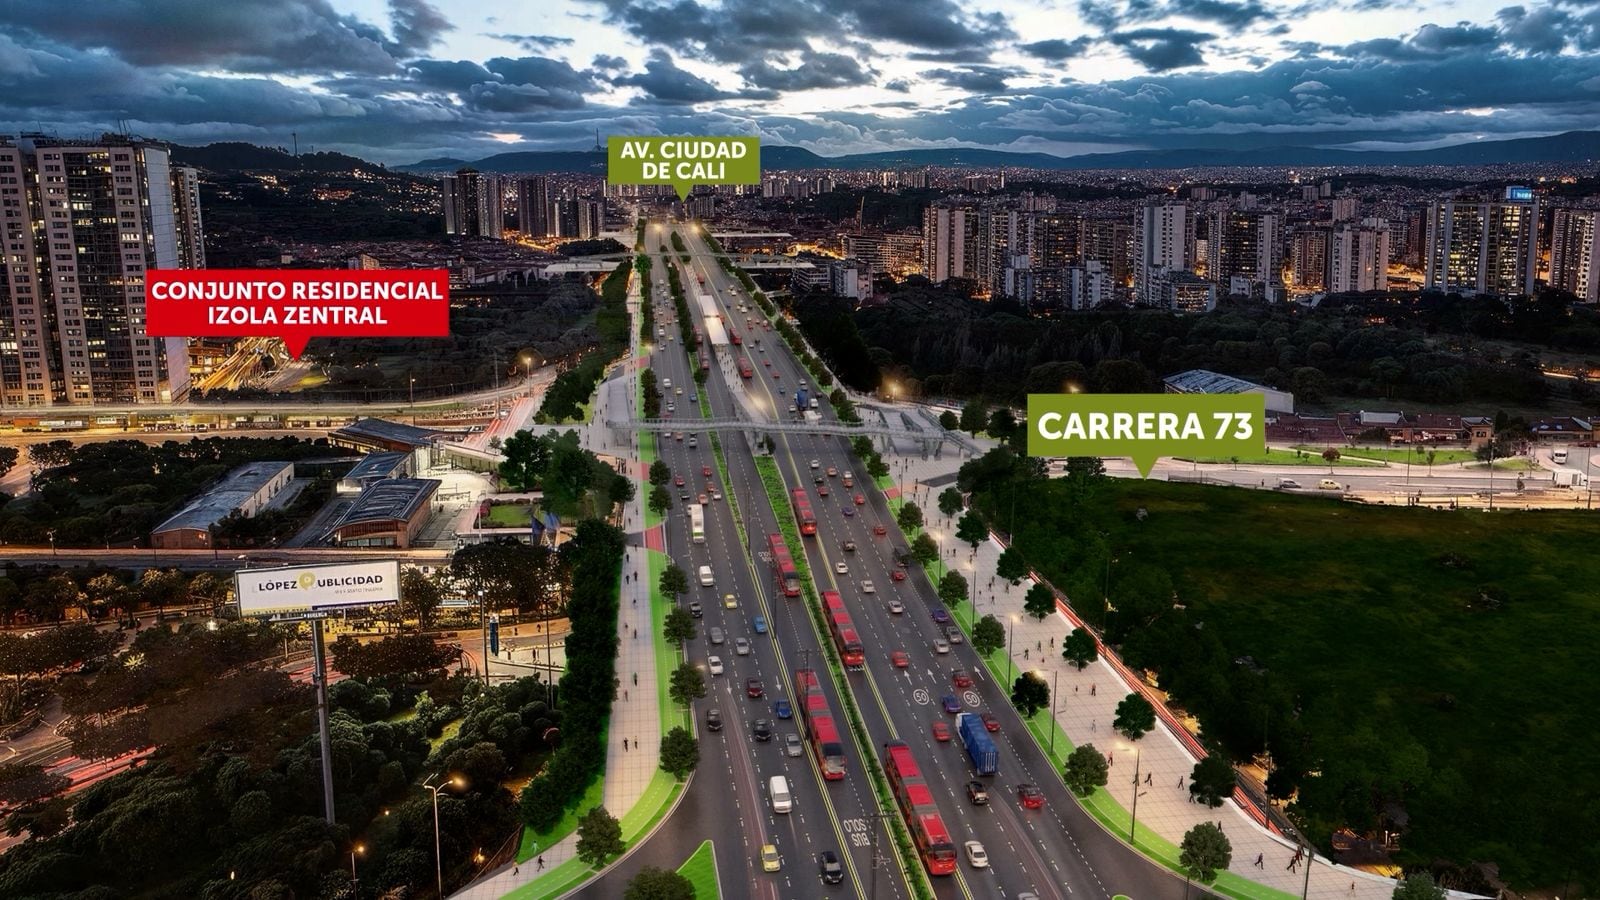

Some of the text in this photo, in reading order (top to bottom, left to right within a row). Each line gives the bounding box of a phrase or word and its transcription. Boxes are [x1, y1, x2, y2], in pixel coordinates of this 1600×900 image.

[915, 691, 927, 702] 50
[965, 694, 977, 704] 50
[851, 832, 871, 847] BUS
